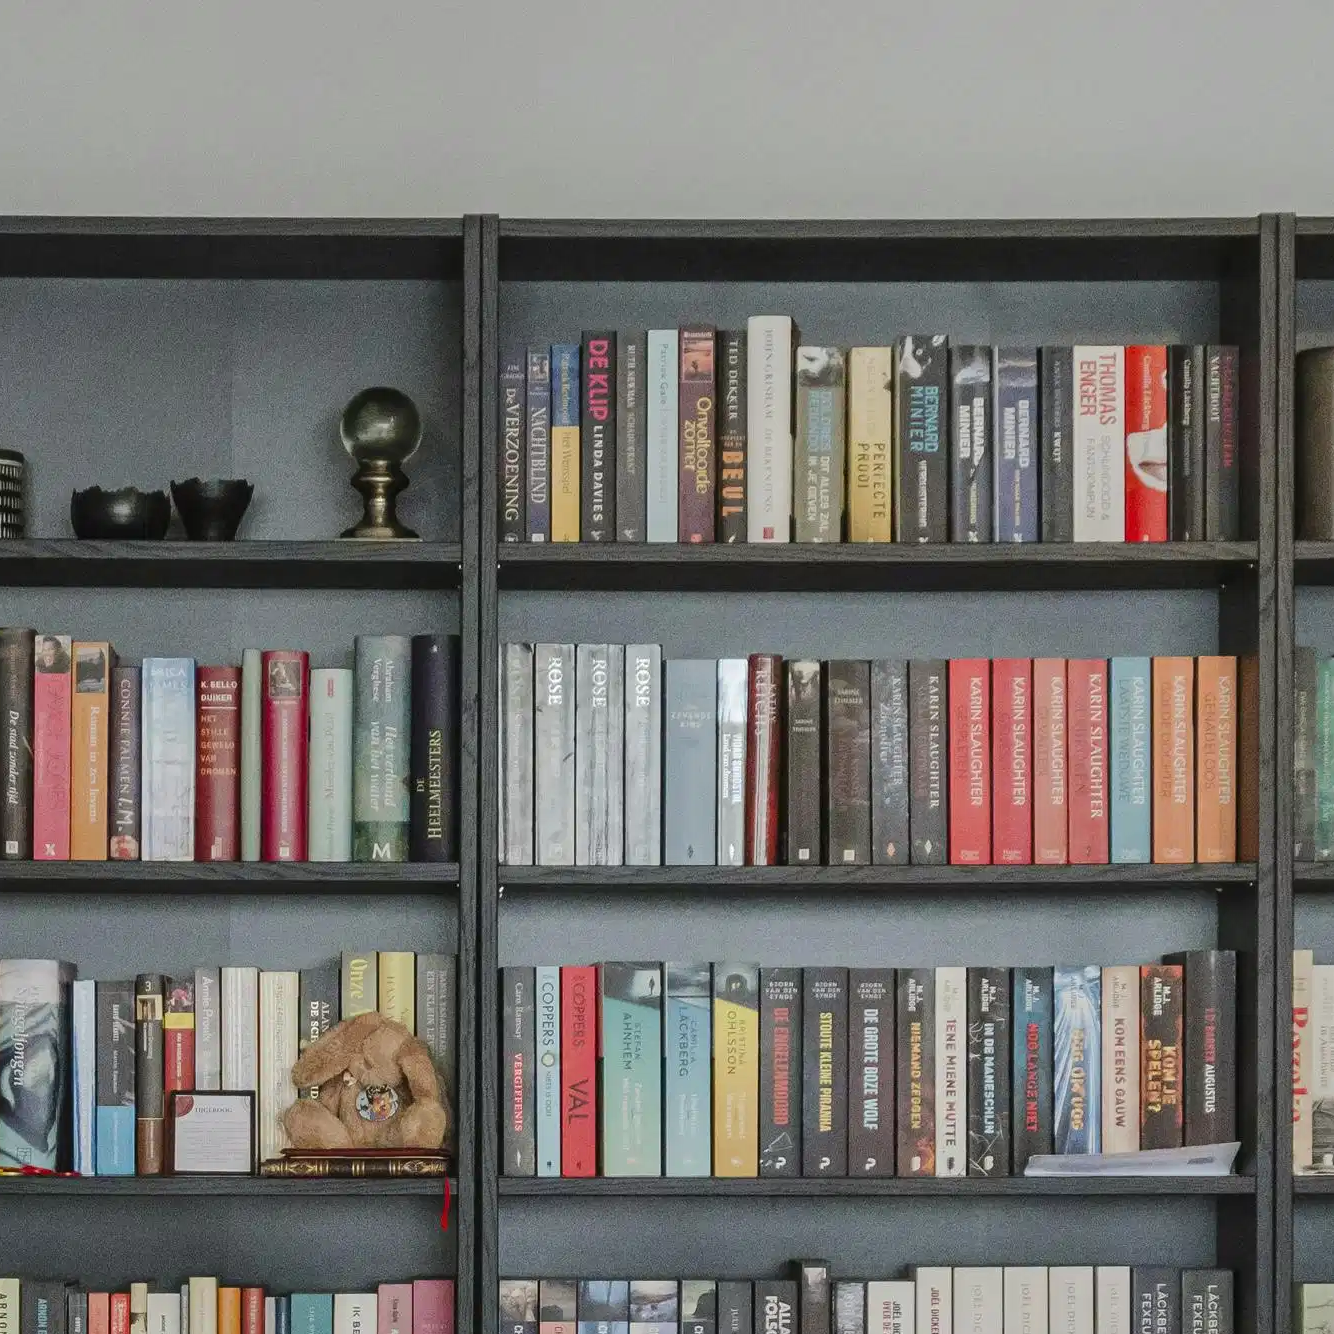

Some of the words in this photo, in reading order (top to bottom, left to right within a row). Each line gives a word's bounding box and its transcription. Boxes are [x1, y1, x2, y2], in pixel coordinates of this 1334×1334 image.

[588, 340, 608, 368] DE
[729, 341, 738, 364] TED
[588, 375, 608, 421] KLIP
[727, 371, 738, 420] DEKKER
[1080, 360, 1096, 416] ENGER
[1099, 353, 1115, 425] THOMAS
[1211, 356, 1219, 422] NACHTBOOT
[910, 386, 923, 453] MINIER
[925, 386, 939, 453] BERNARD
[505, 404, 518, 521] VERZOENING
[530, 408, 547, 504] NACHTBLIND
[593, 425, 603, 467] LINDA
[683, 420, 696, 471] zomer
[696, 397, 711, 494] Onvoltooide
[858, 443, 869, 489] PROOI
[593, 473, 603, 522] DAVIES
[722, 452, 744, 517] BEUL
[873, 443, 885, 519] PERFECTE
[549, 657, 563, 705] ROSE
[636, 657, 650, 707] ROSE
[930, 676, 939, 720] KARIN
[970, 677, 982, 720] KARIN
[1090, 673, 1102, 721] KARIN
[9, 711, 19, 727] De
[121, 680, 131, 735] CONNIE
[9, 729, 19, 750] stad
[9, 752, 19, 786] zonder
[121, 741, 131, 794] PALMEN
[427, 731, 442, 839] HEELMEESTERS
[930, 725, 939, 809] SLAUGHTER
[970, 724, 982, 805] SLAUGHTER
[1090, 727, 1102, 818] SLAUGHTER
[7, 788, 19, 804] tijd
[350, 959, 366, 999] Onze
[1154, 977, 1162, 1016] ARLIDGE
[542, 982, 554, 1046] COPPERS
[573, 983, 585, 1047] COPPERS
[820, 1013, 832, 1048] STOUTE
[864, 1009, 878, 1023] DE
[946, 1019, 957, 1050] IENE
[984, 1023, 994, 1034] IN
[1114, 1018, 1125, 1046] KOM
[623, 1012, 632, 1070] AHNHEM
[727, 1011, 737, 1075] OHLSSON
[864, 1027, 878, 1063] GROTE
[984, 1038, 994, 1053] DE
[820, 1051, 832, 1084] KLEINE
[864, 1066, 878, 1094] BOZE
[946, 1055, 957, 1096] MIENE
[1114, 1050, 1125, 1083] EENS
[1147, 1039, 1161, 1112] SPELEN?
[1163, 1046, 1176, 1083] KOM
[514, 1053, 523, 1131] VERGIFFENIS
[568, 1079, 588, 1124] VAL
[820, 1088, 832, 1131] PIRANHA
[984, 1056, 994, 1134] MANESCHIJN
[1114, 1088, 1125, 1127] GAUW
[1163, 1086, 1176, 1105] JE
[1205, 1064, 1215, 1113] AUGUSTUS
[864, 1098, 878, 1129] WOLF
[946, 1101, 957, 1146] MUTTE
[352, 1306, 360, 1317] IK
[931, 1287, 940, 1306] JOËL
